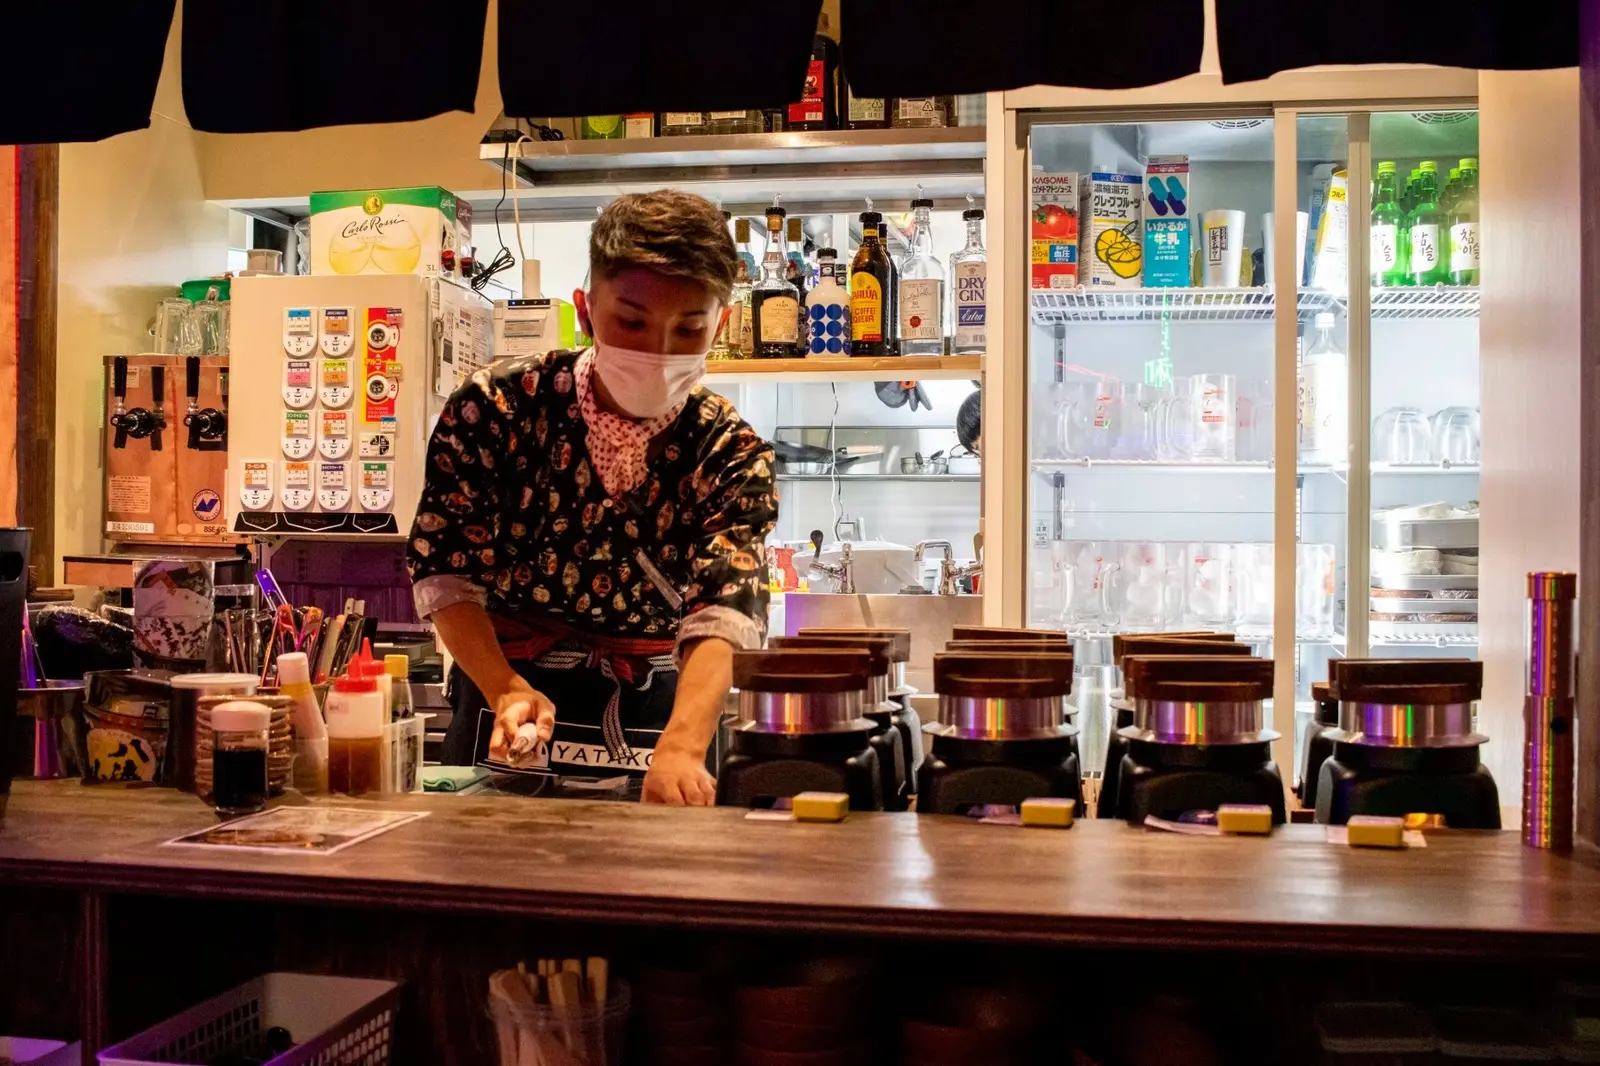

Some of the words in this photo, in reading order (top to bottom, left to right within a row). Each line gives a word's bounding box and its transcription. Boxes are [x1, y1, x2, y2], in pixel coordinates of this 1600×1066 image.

[1094, 208, 1127, 217] ジュース
[342, 222, 368, 238] Carlo
[370, 214, 405, 235] Rossi
[1147, 222, 1186, 231] いかるが
[1154, 232, 1180, 245] 牛乳
[959, 277, 986, 289] DRY
[959, 290, 984, 301] GIN
[962, 309, 983, 321] Extra
